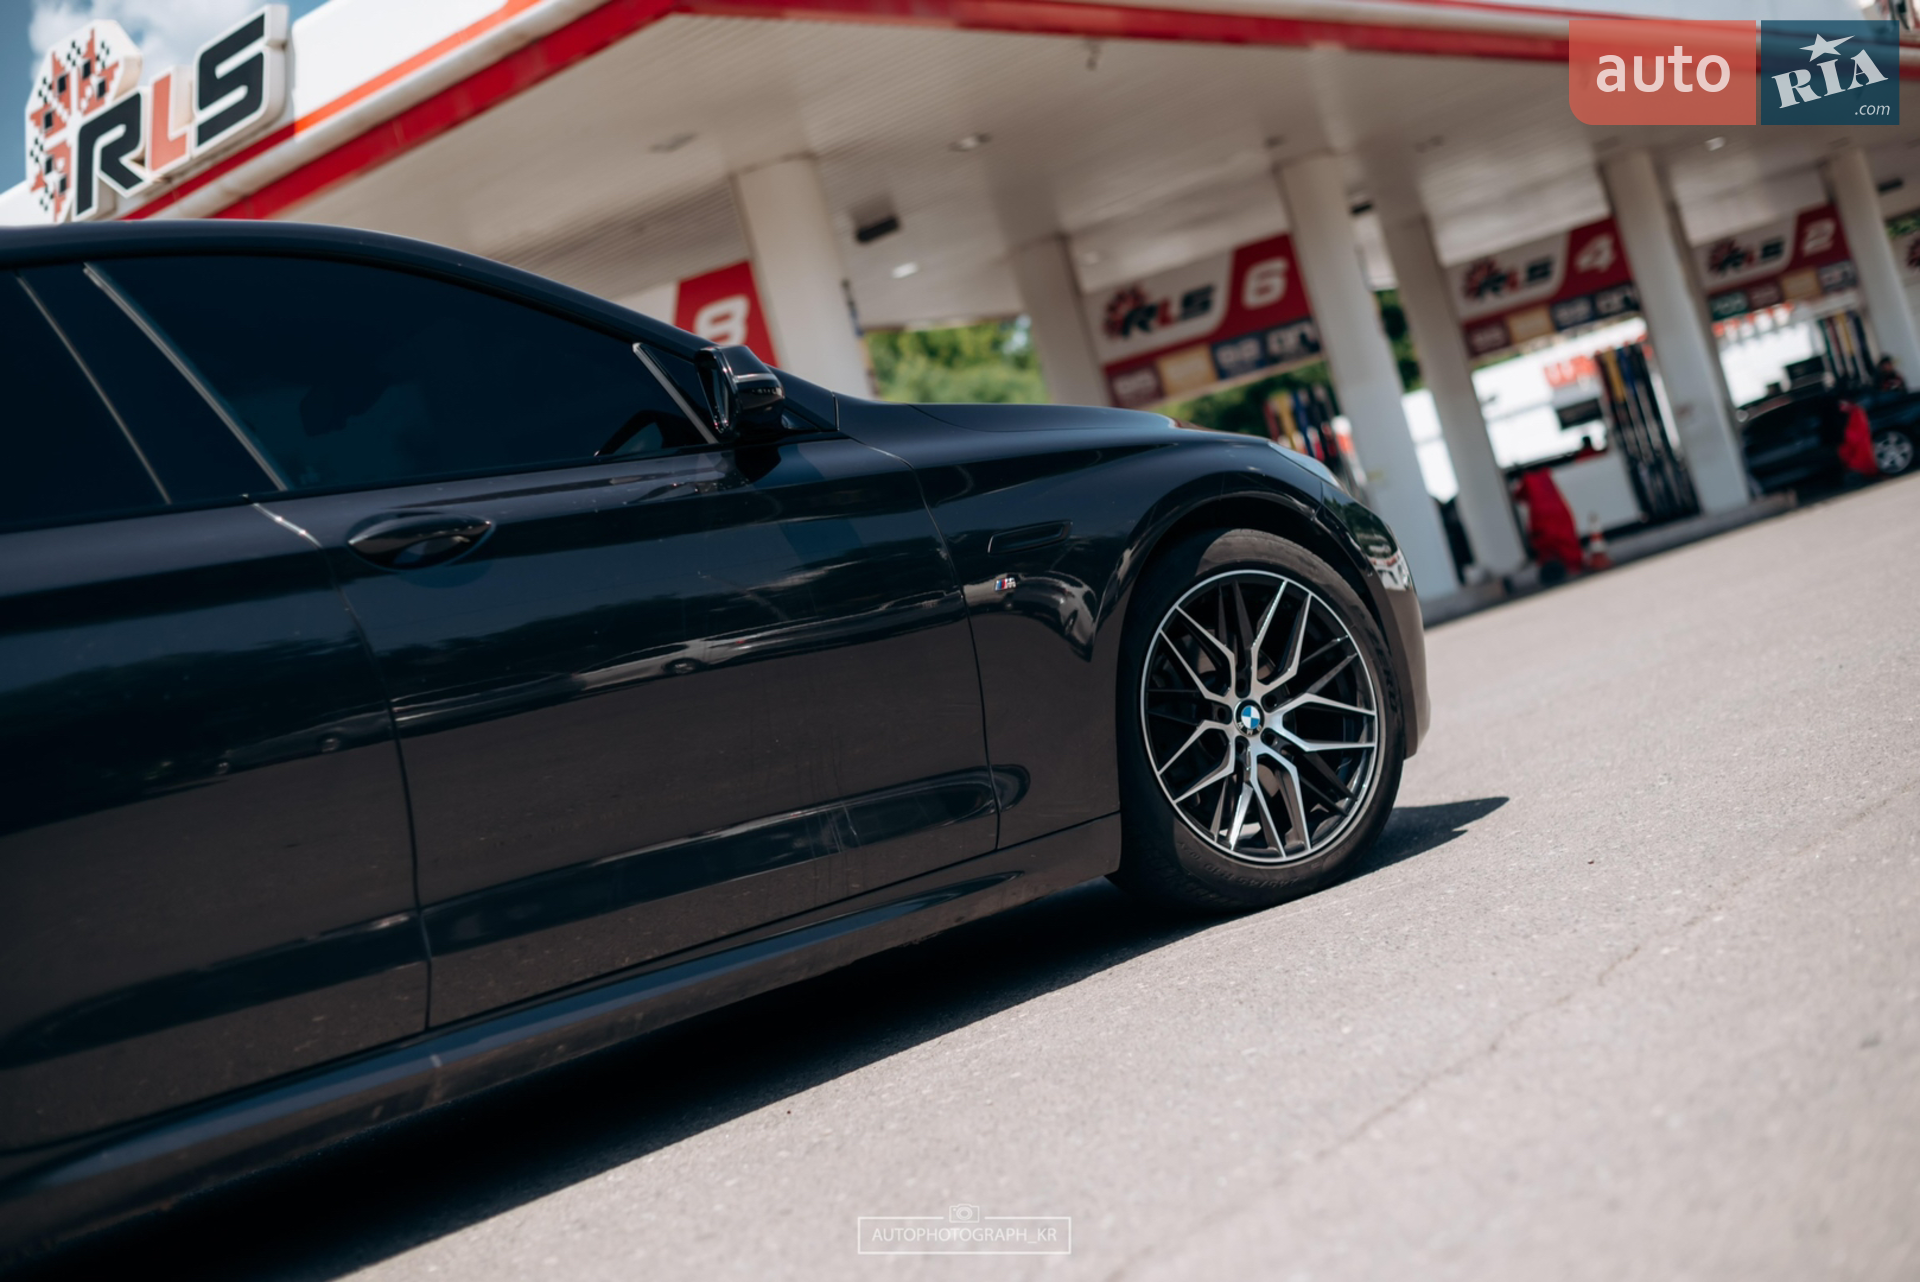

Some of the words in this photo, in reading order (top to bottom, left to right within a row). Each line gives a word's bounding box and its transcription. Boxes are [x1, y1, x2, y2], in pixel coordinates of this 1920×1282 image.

[76, 12, 266, 217] RLS
[1574, 232, 1616, 274] 4
[1800, 217, 1837, 258] 2
[1241, 257, 1290, 310] 6
[693, 294, 750, 346] 8
[1122, 285, 1215, 337] RLS
